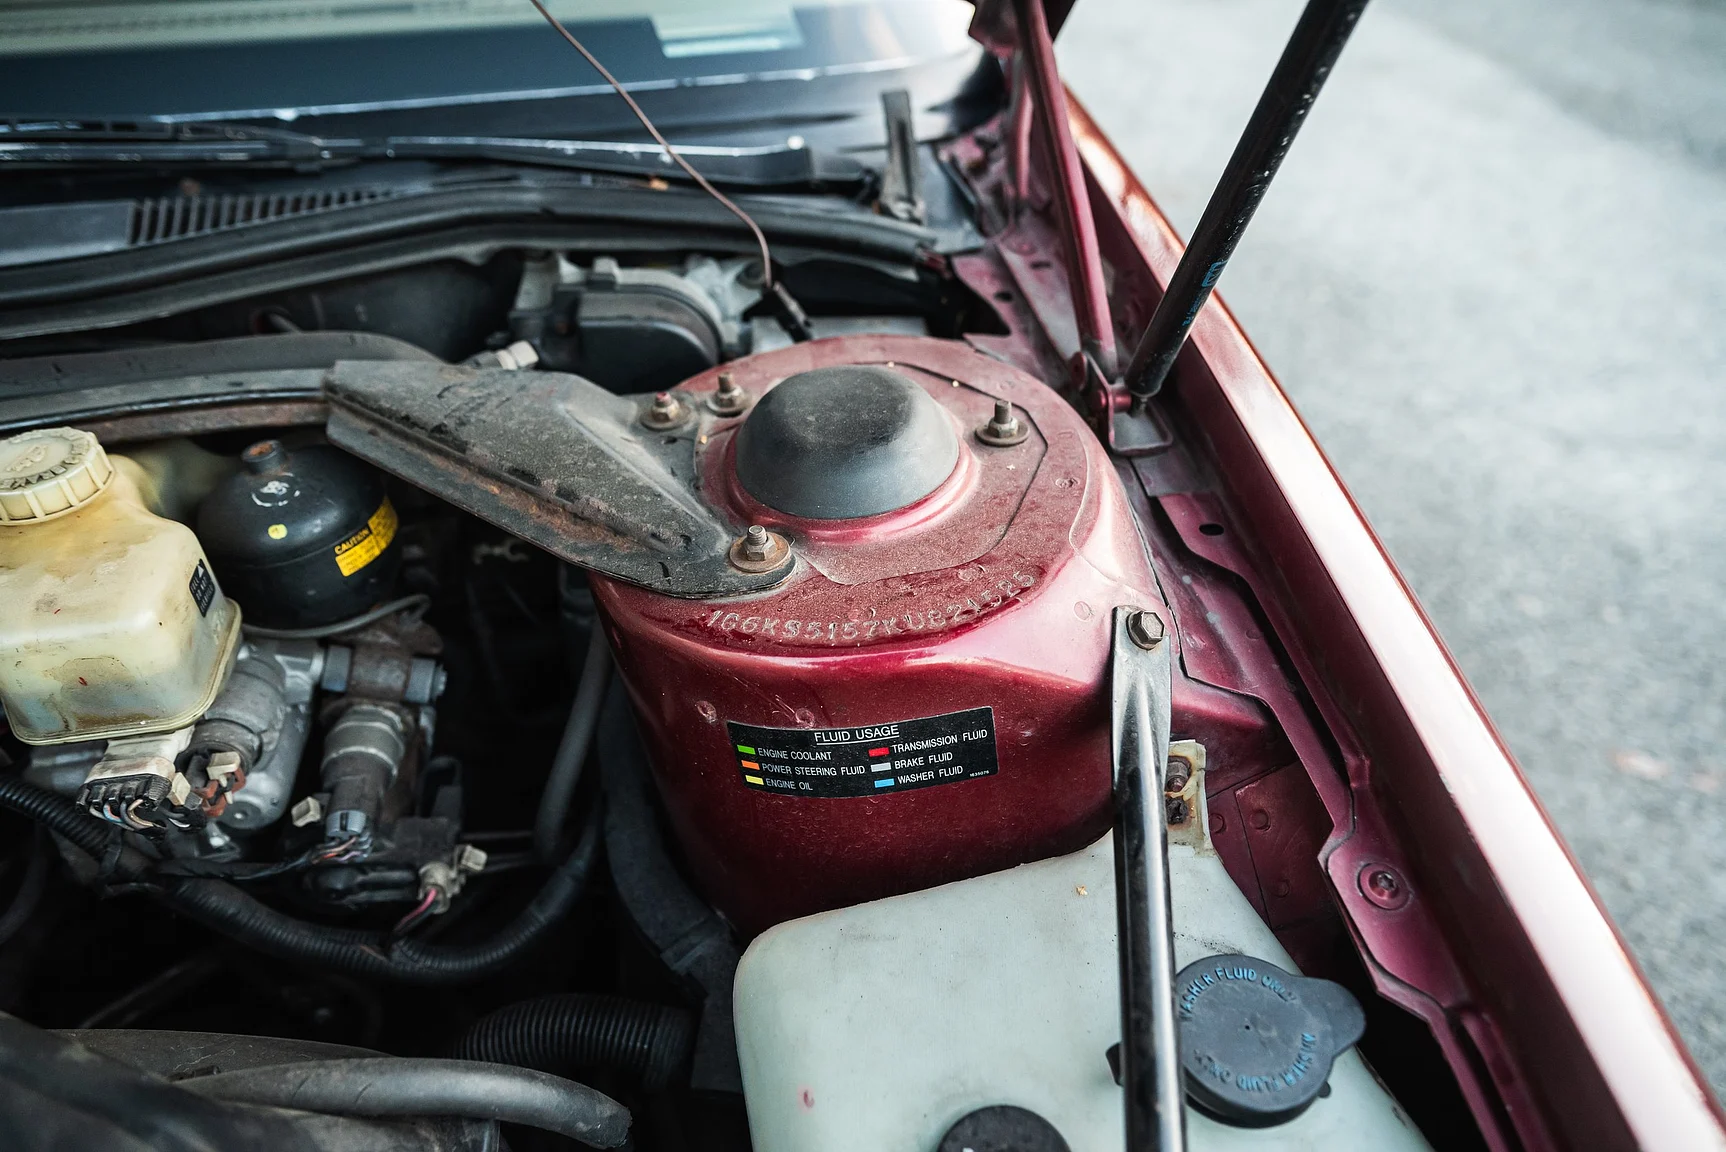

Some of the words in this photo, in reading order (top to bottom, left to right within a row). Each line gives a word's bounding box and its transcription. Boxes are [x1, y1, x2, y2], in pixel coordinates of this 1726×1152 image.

[814, 730, 851, 742] FLUID
[855, 725, 900, 740] USAGE
[891, 734, 958, 754] TRANSMISSION
[962, 729, 988, 742] FLUID
[757, 747, 789, 760] ENGINE
[790, 751, 832, 761] COOLANT
[894, 756, 925, 770] BRAKE
[928, 752, 953, 764] FLUID
[761, 762, 793, 775] POWER
[794, 766, 837, 776] STEERING
[841, 765, 866, 776] FLUID
[897, 770, 935, 785] WASHER
[938, 765, 964, 778] FLUID
[765, 778, 797, 790] ENGINE
[798, 781, 814, 791] OIL
[1214, 966, 1258, 982] FLUID
